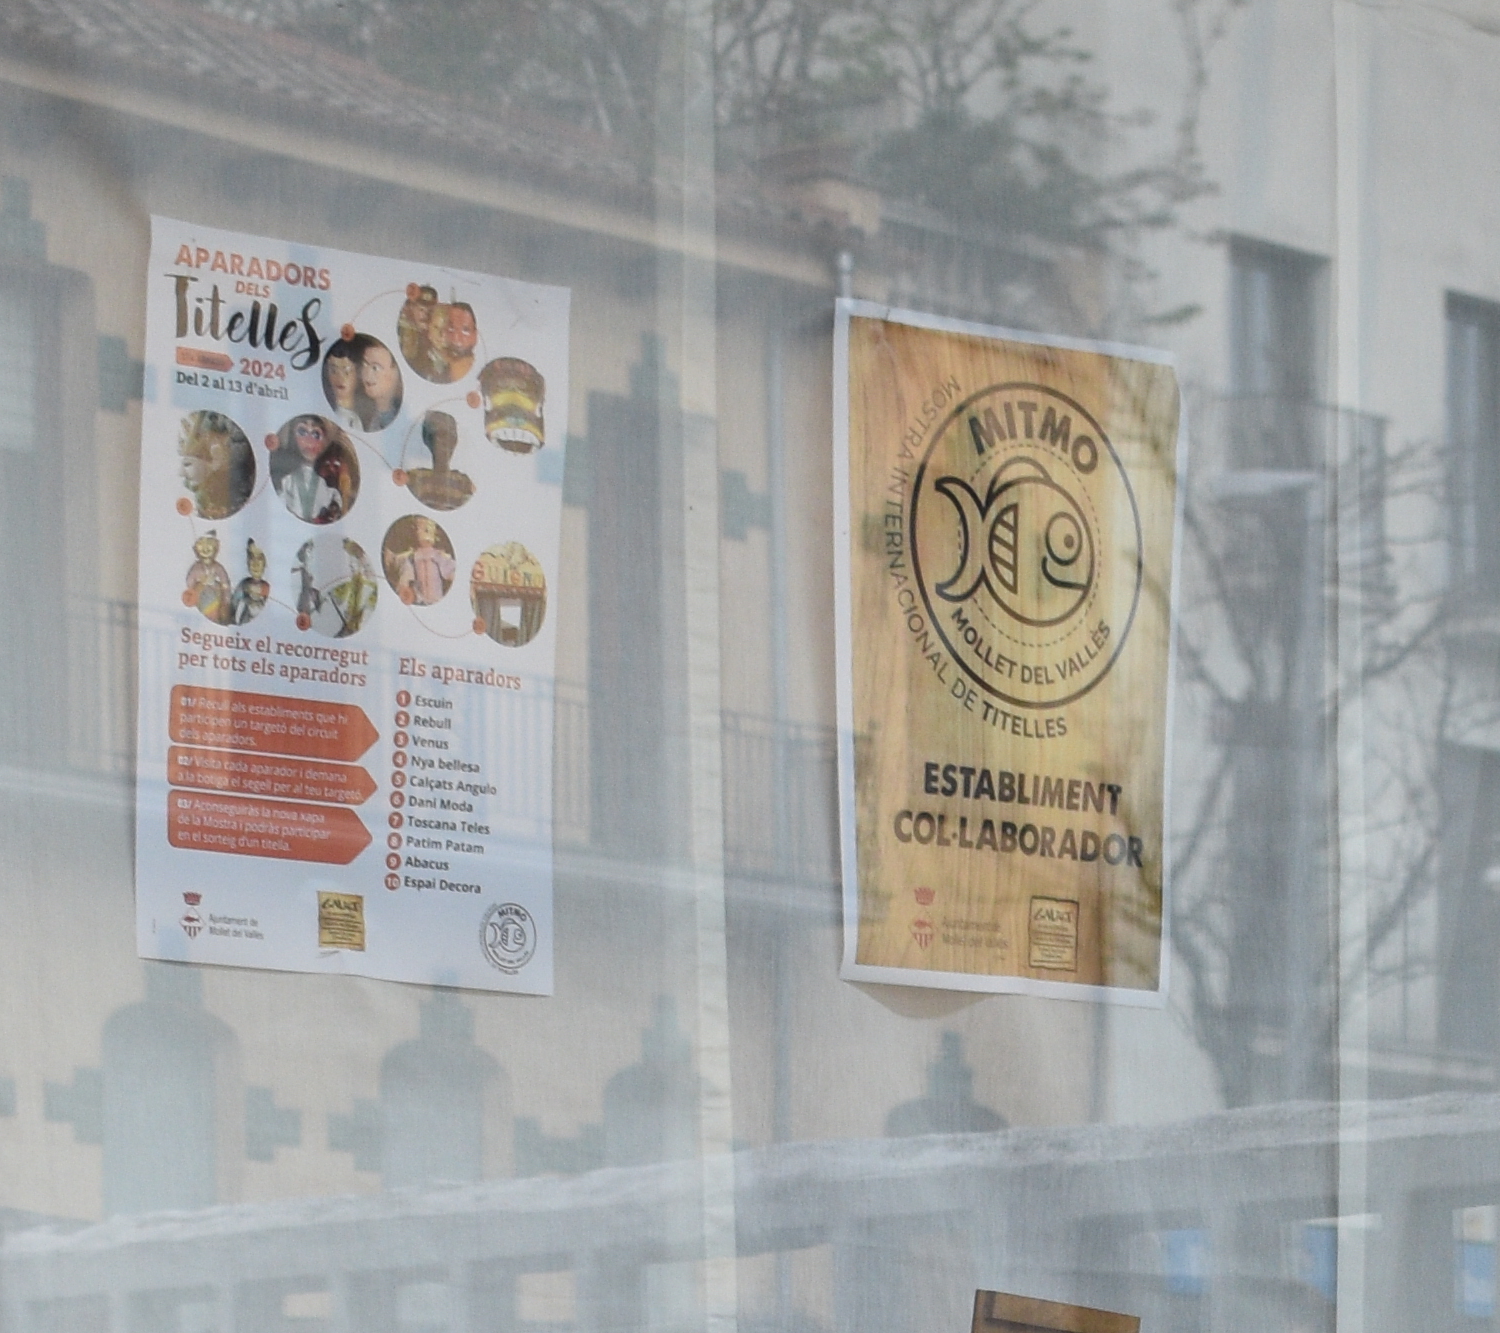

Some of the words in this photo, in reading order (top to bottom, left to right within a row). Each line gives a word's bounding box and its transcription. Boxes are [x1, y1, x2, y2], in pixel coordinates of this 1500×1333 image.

[174, 245, 331, 290] APARADORS
[235, 281, 271, 298] DELS
[240, 358, 286, 381] 2024
[176, 371, 198, 386] Del
[202, 375, 209, 388] 2
[212, 378, 225, 390] al
[229, 380, 242, 393] 13
[246, 382, 289, 400] d'abril
[896, 374, 962, 461] MOSTRA
[969, 401, 1098, 475] MITMO
[884, 470, 947, 685] INTERNACIONAL
[181, 627, 252, 651] Segueix
[255, 636, 271, 653] el
[276, 642, 369, 668] recorregut
[951, 606, 1018, 679] MOLLET
[1021, 665, 1055, 685] DEL
[1056, 619, 1111, 680] VALLÈS
[178, 652, 207, 669] per
[213, 654, 246, 672] tots
[251, 658, 275, 676] els
[279, 664, 366, 686] aparadors
[399, 657, 426, 677] Els
[431, 665, 521, 690] aparadors
[415, 695, 453, 709] Escuin
[951, 678, 978, 712] DE
[413, 715, 451, 729] Rebull
[982, 699, 1068, 739] TITELLES
[412, 735, 449, 750] Venus
[411, 755, 435, 770] Nya
[439, 757, 480, 773] bellesa
[410, 775, 453, 791] Calçats
[456, 780, 497, 796] Angulo
[923, 761, 1122, 816] ESTABLIMENT
[409, 795, 436, 809] Dani
[440, 800, 473, 813] Moda
[407, 815, 457, 831] Toscana
[461, 821, 490, 835] Teles
[893, 809, 1145, 868] COL·LABORADOR
[406, 835, 442, 850] Patim
[446, 839, 484, 854] Patam
[405, 856, 450, 871] Abacus
[404, 876, 436, 892] Espai
[440, 879, 481, 893] Decora
